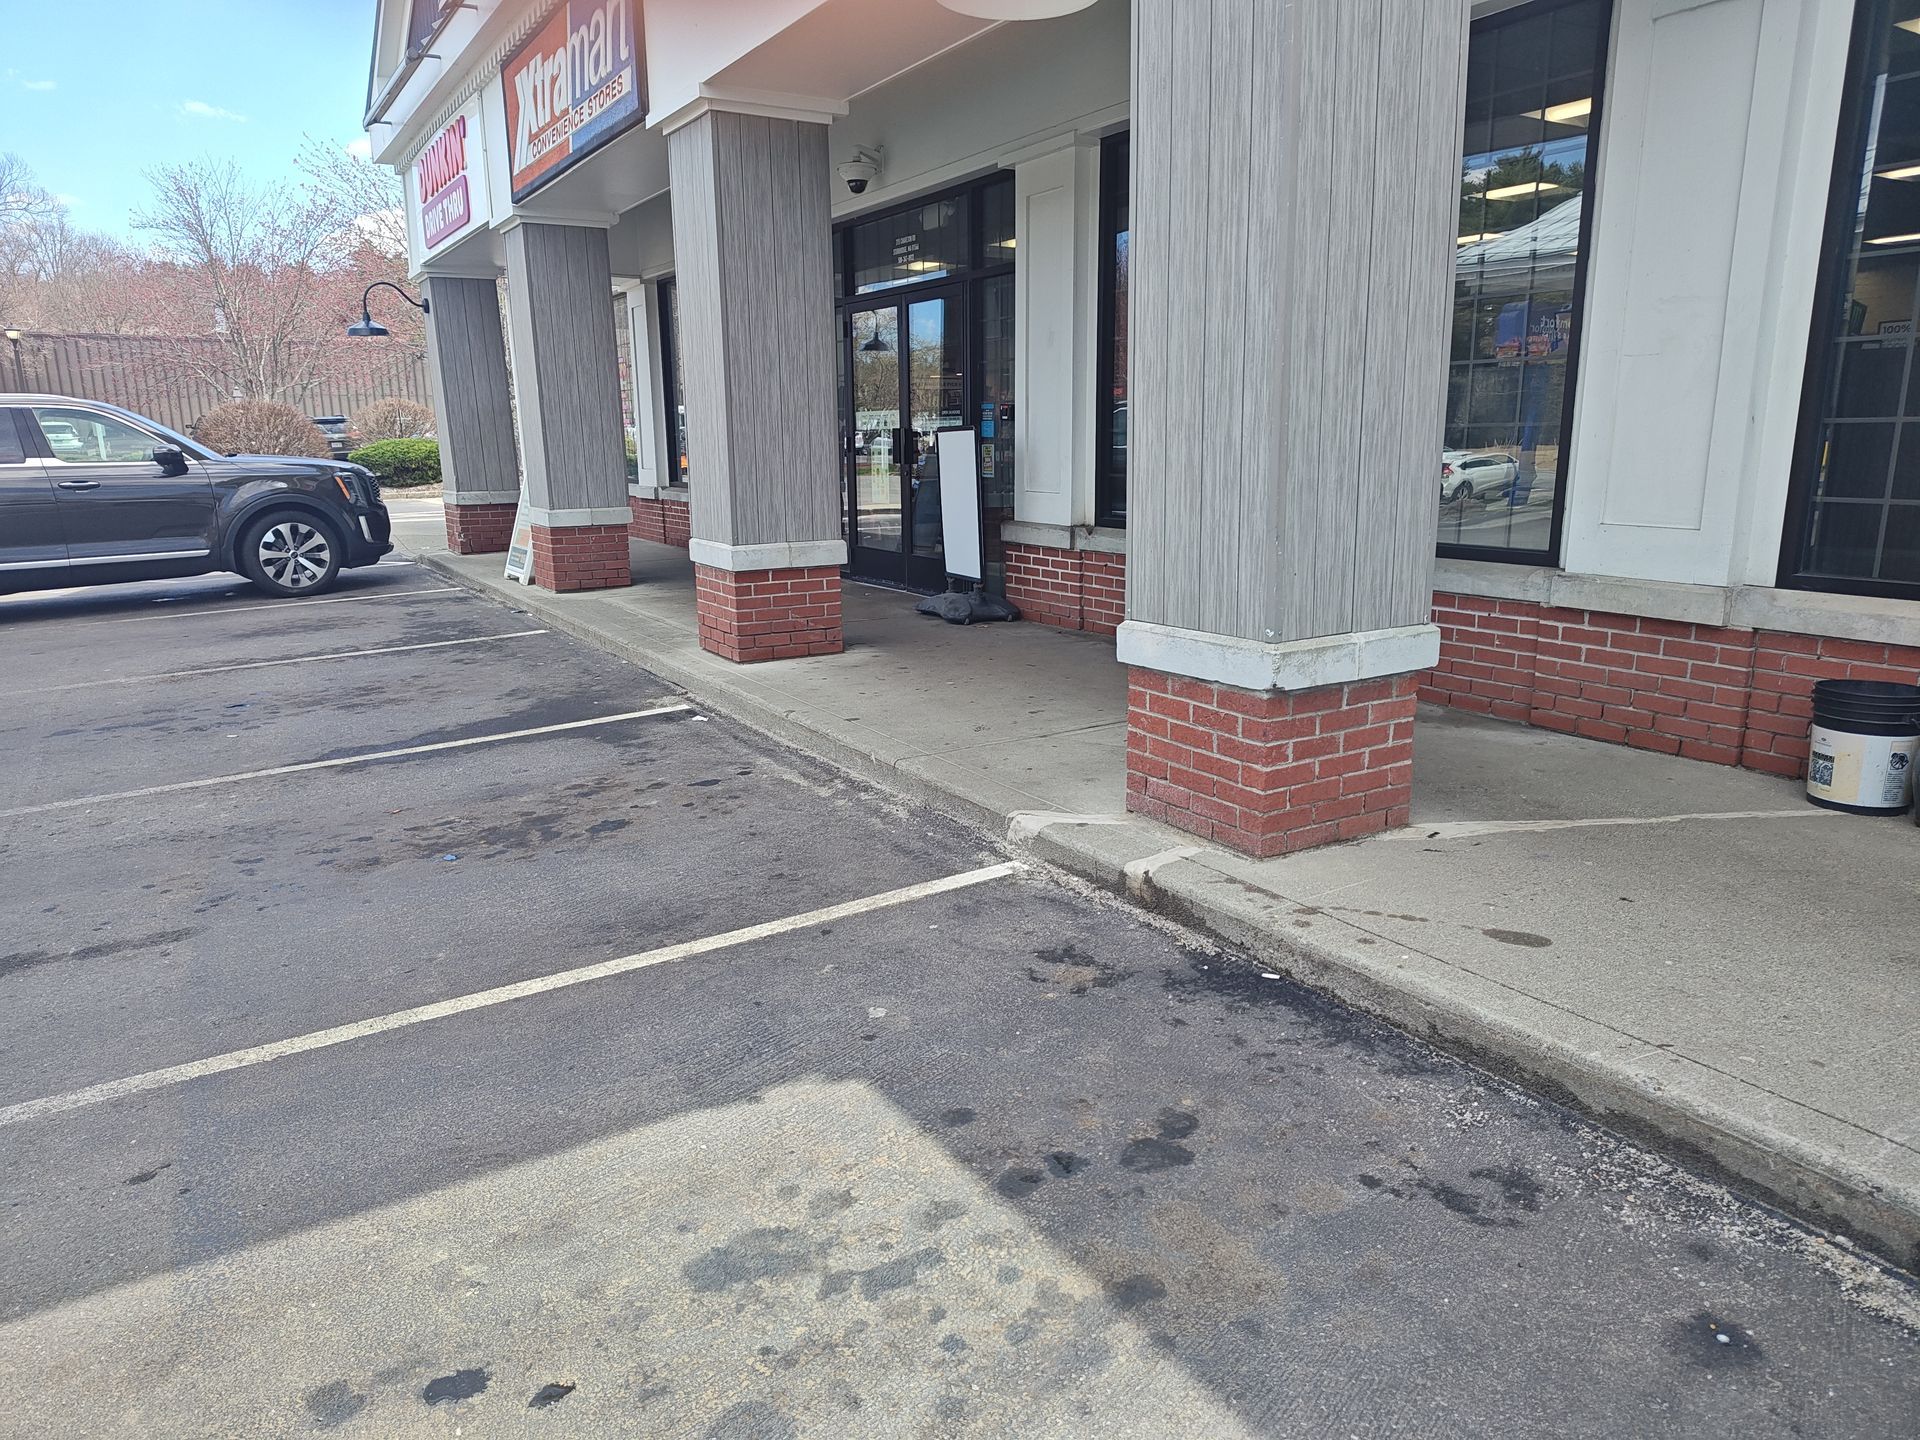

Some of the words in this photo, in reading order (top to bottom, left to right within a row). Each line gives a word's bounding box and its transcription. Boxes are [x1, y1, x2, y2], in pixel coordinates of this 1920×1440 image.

[513, 0, 629, 176] Xtramart
[531, 107, 585, 159] CONVENIENCE
[587, 74, 624, 118] STORES
[424, 201, 444, 239] DRIVE
[442, 186, 465, 226] THRU
[1883, 323, 1911, 334] 100%
